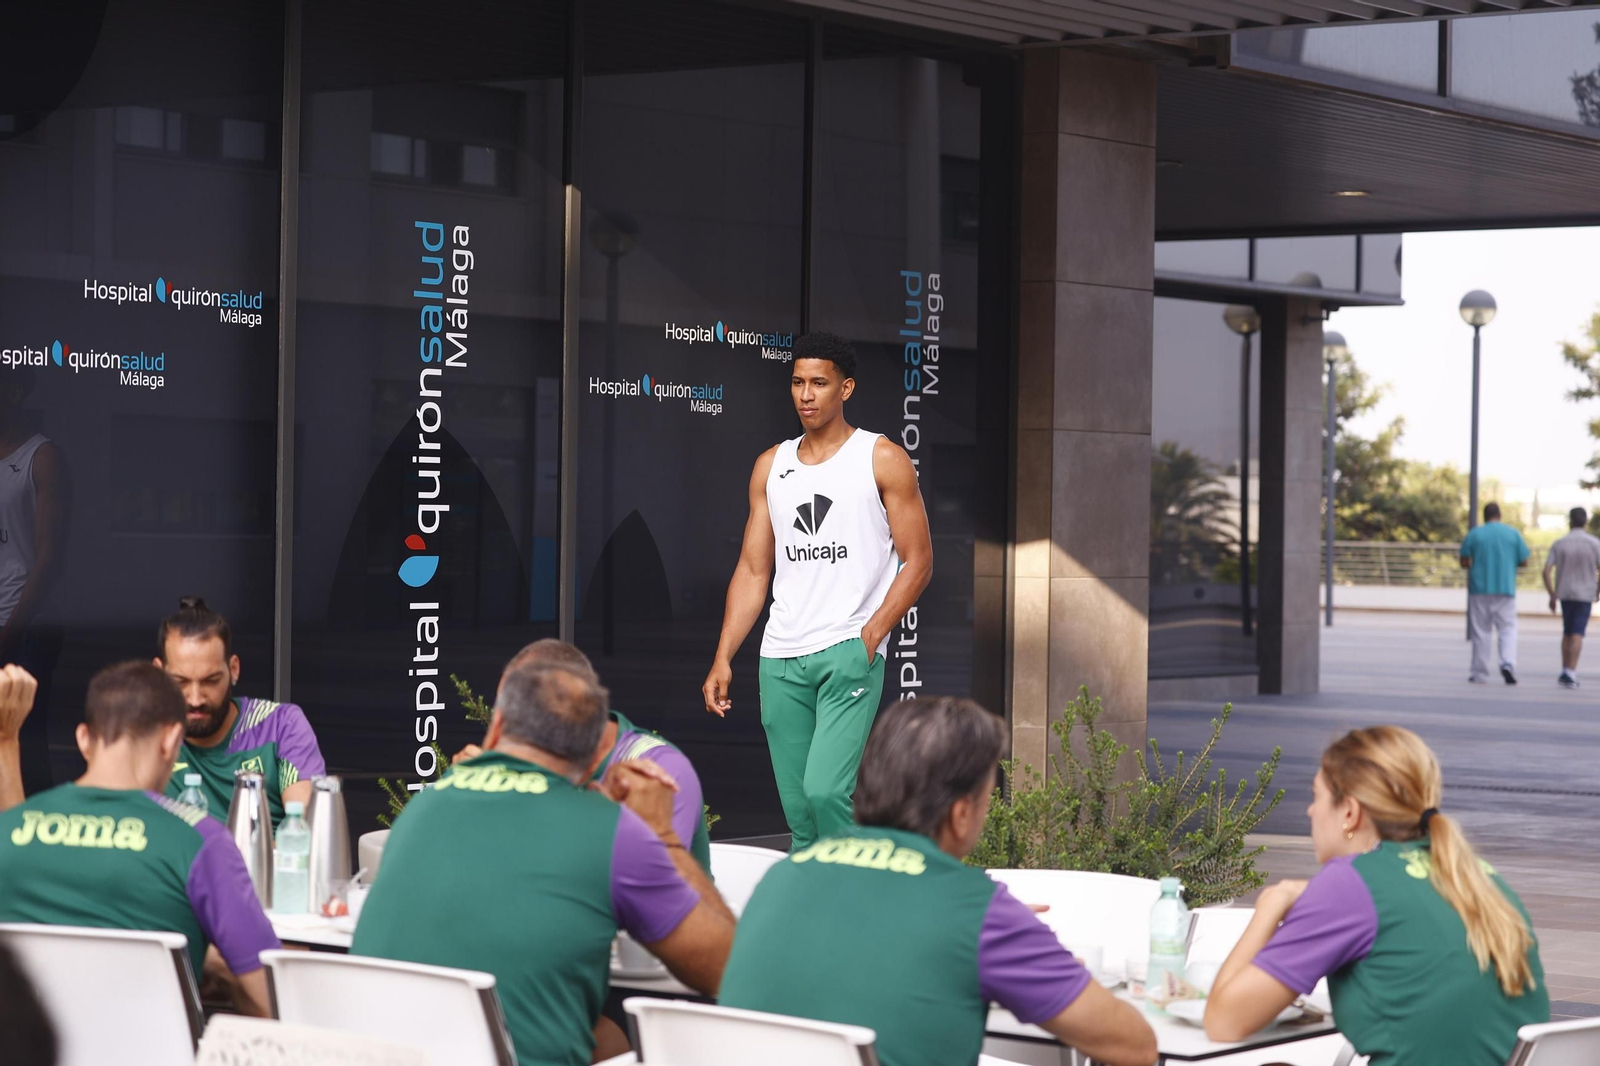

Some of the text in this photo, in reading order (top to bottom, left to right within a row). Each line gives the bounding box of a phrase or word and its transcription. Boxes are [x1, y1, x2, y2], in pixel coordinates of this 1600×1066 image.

[84, 278, 262, 310] Hospital quirónsalud
[445, 225, 474, 367] Málaga
[219, 308, 262, 328] Málaga
[665, 322, 793, 348] Hospital quirónsalud
[922, 273, 944, 395] Málaga
[0, 345, 165, 373] spital quirónsalud
[761, 346, 793, 363] Málaga
[119, 371, 165, 390] Málaga
[412, 221, 450, 534] quirónsalud
[589, 376, 723, 402] Hospital quirónsalud
[690, 399, 723, 415] Málaga
[785, 541, 848, 564] Unicaja
